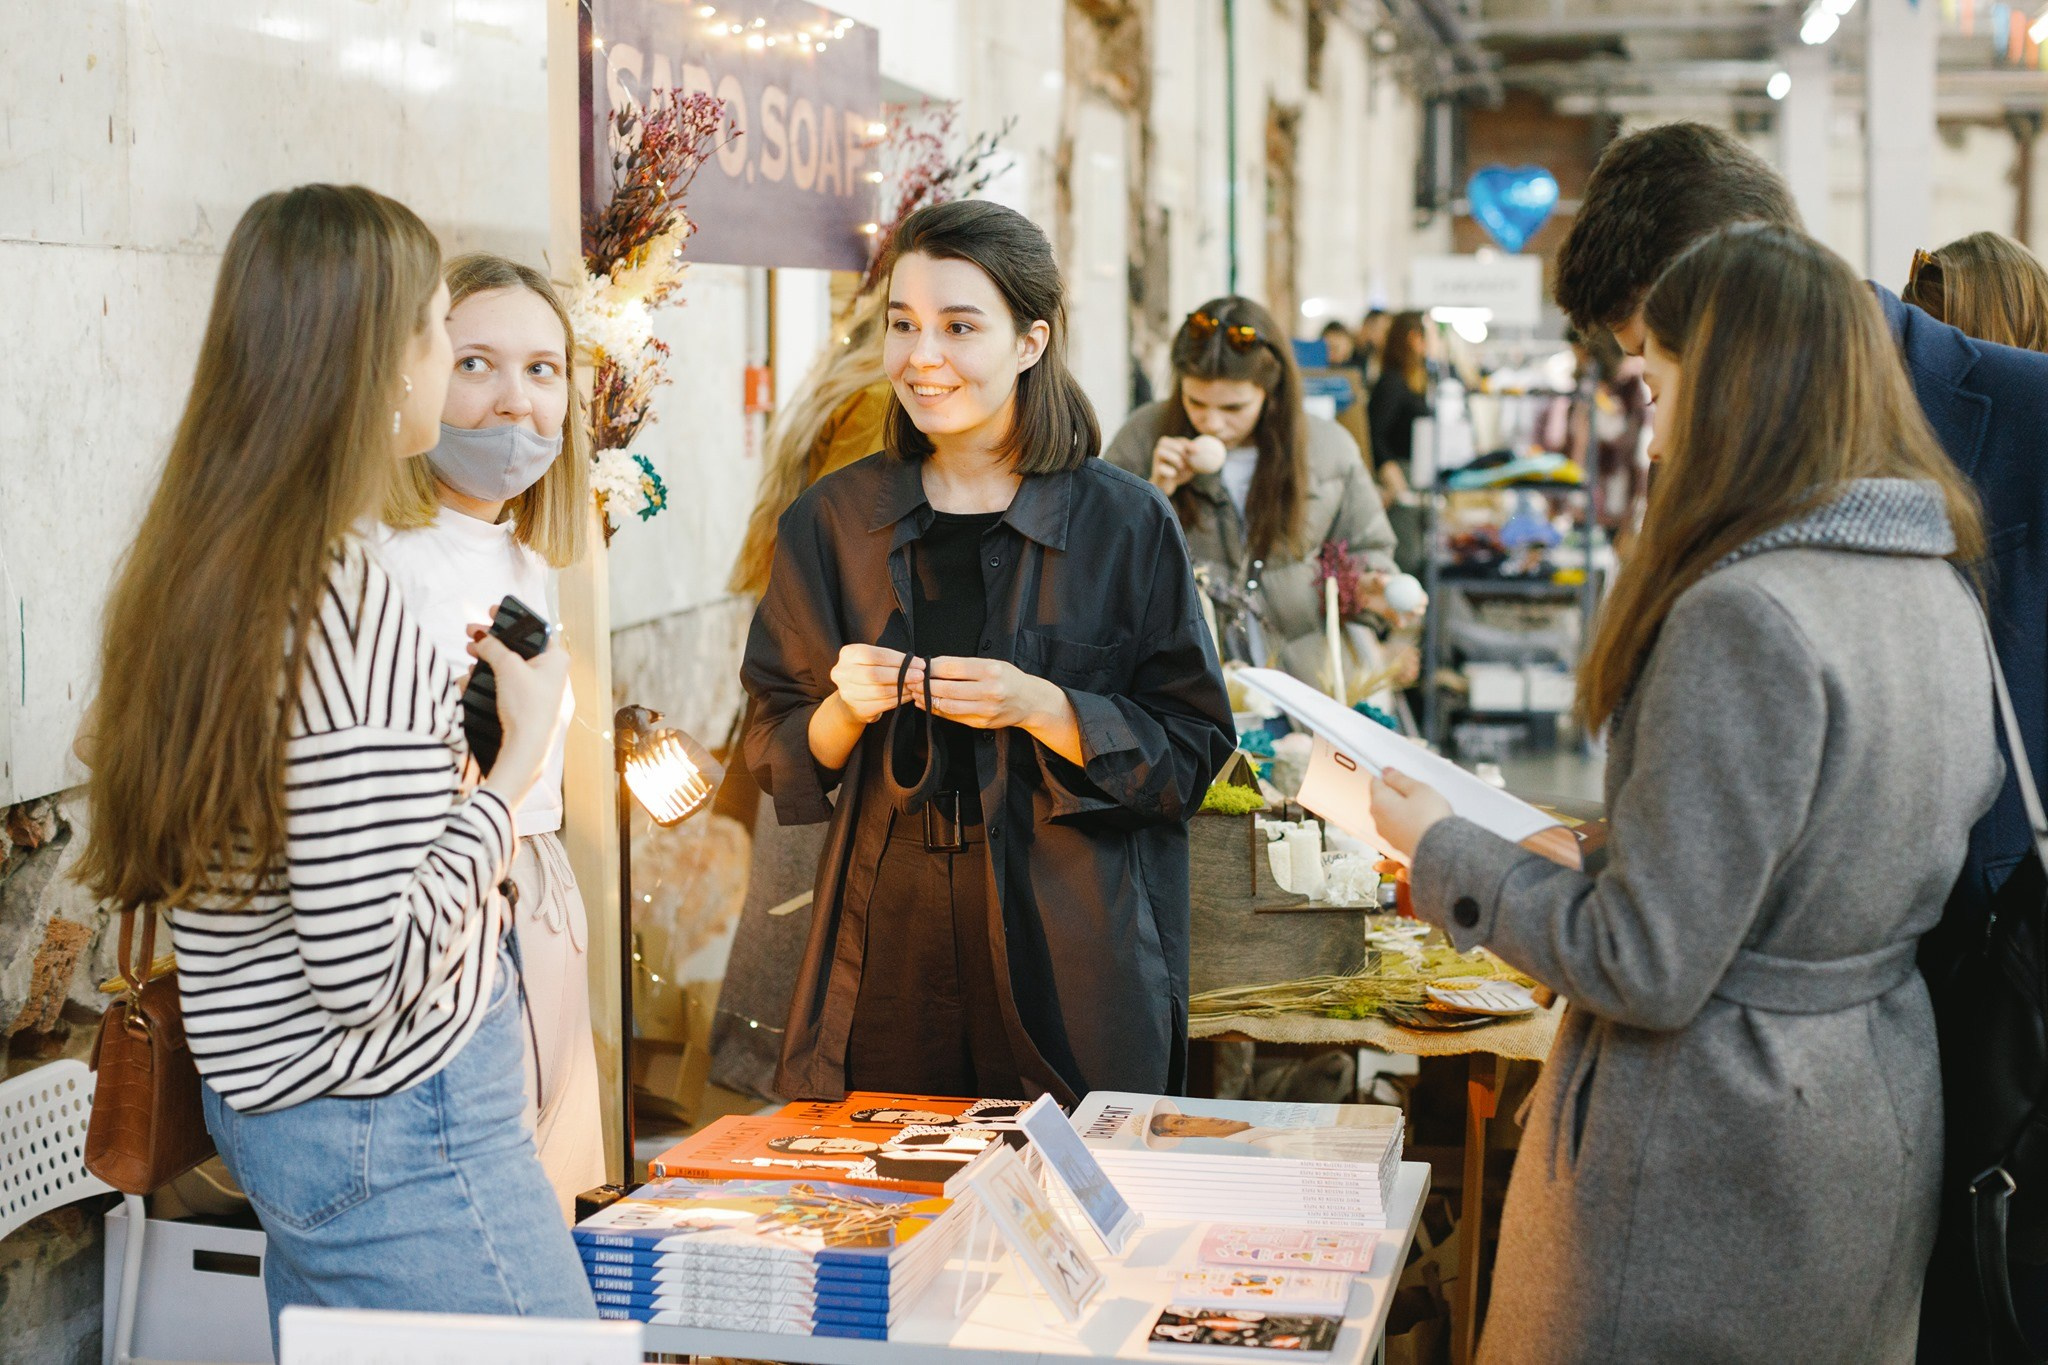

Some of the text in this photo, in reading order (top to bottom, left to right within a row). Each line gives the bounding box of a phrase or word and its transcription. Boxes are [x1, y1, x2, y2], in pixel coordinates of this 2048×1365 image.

[1083, 1105, 1134, 1139] ORNAMENT
[595, 1235, 634, 1248] ORNAMENT
[595, 1250, 634, 1264] ORNAMENT
[594, 1264, 633, 1278] ORNAMENT
[595, 1277, 633, 1291] ORNAMENT
